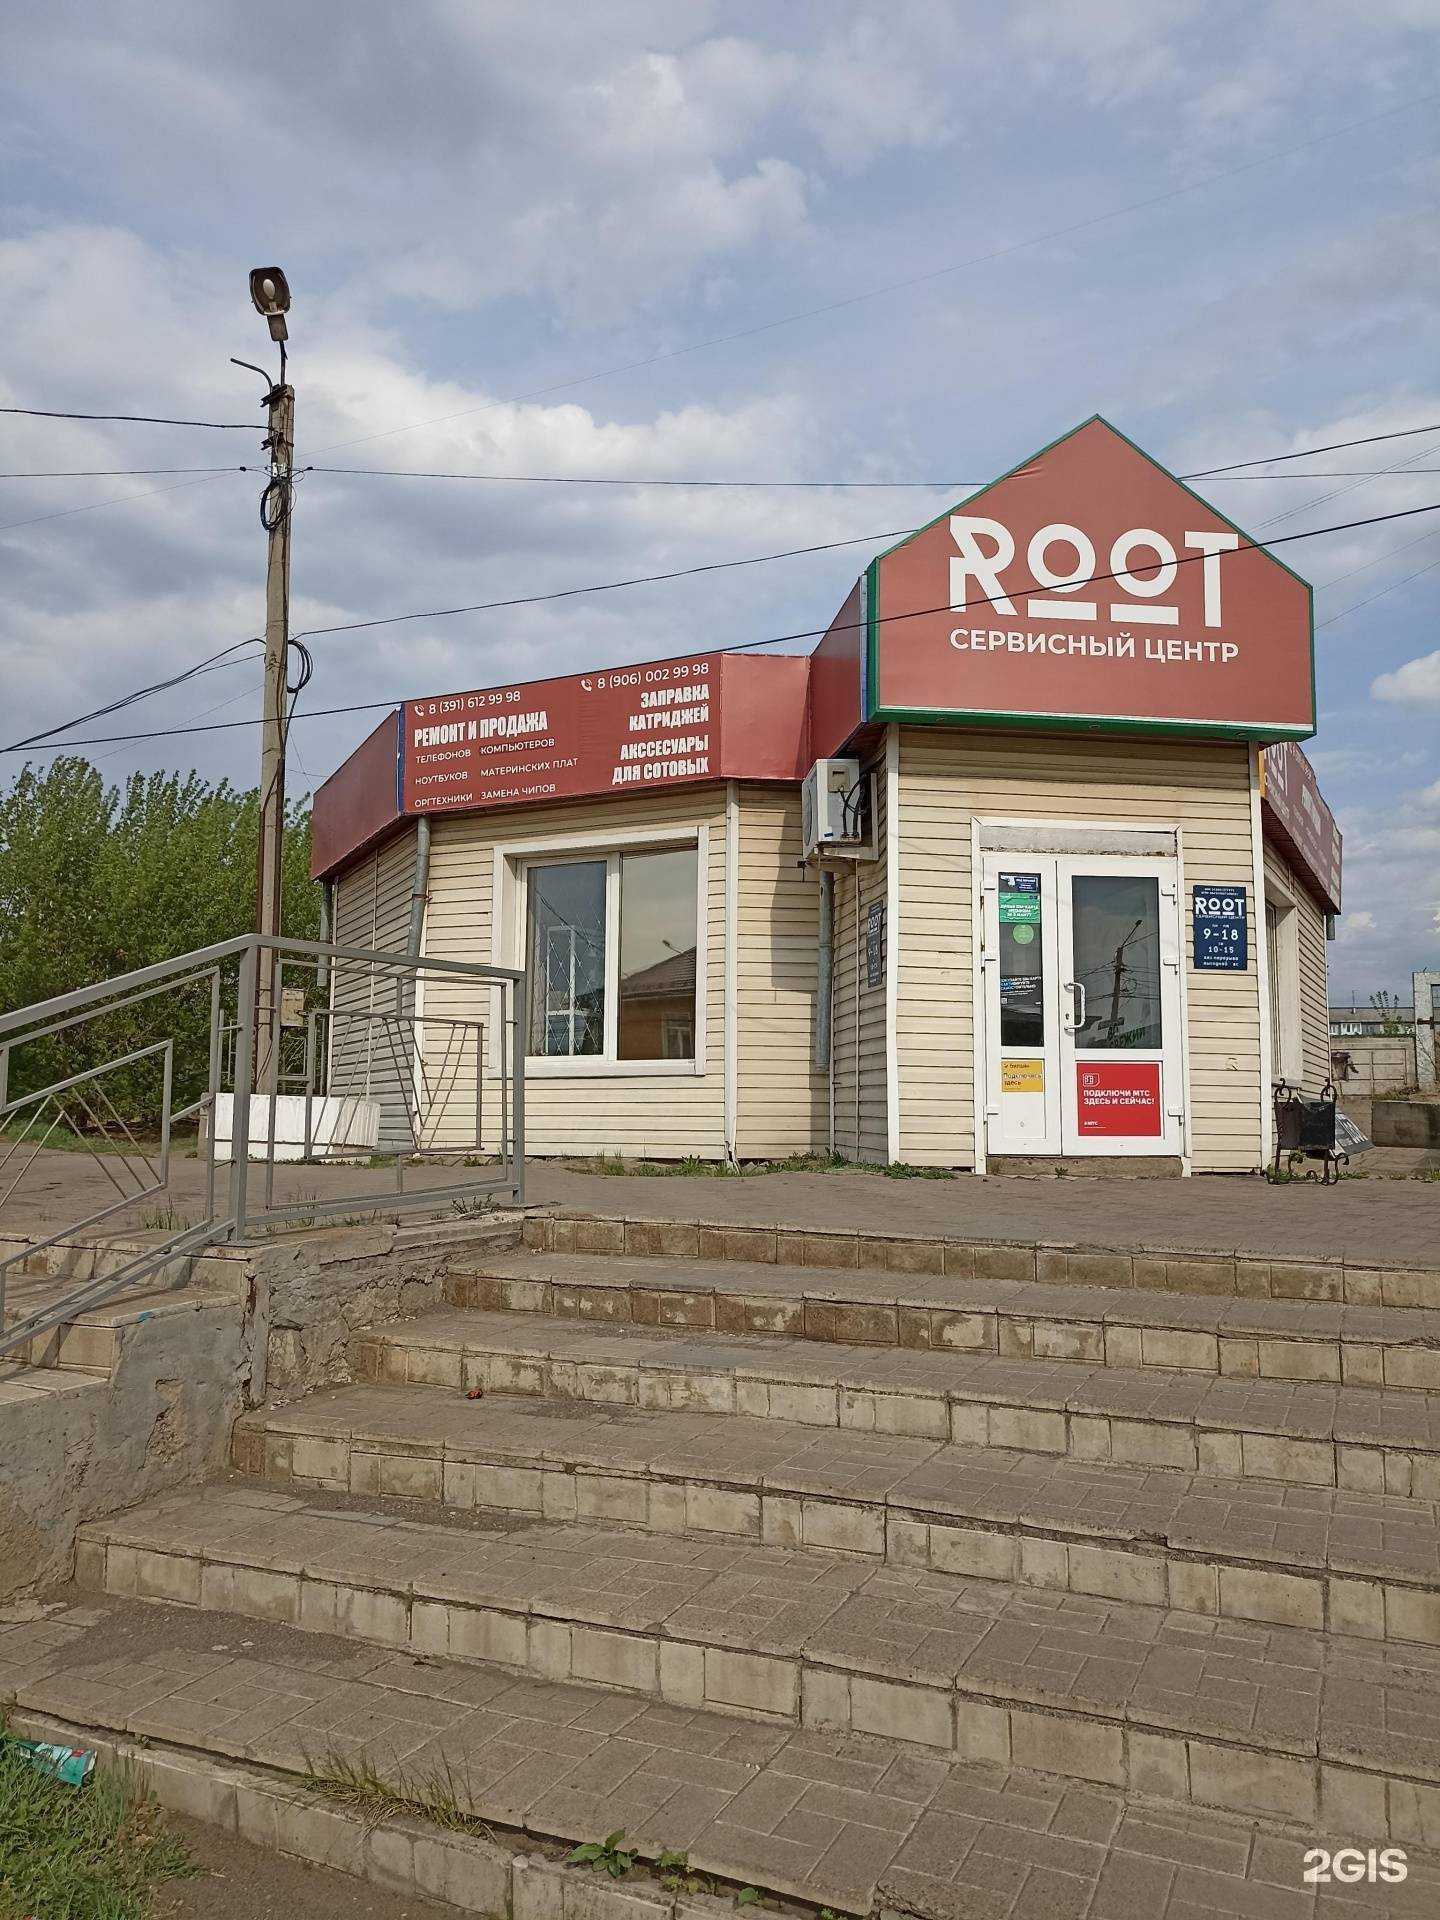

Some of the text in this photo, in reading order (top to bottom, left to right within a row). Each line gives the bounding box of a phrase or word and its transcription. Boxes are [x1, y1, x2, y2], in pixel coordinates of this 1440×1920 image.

[949, 514, 1239, 628] ROOT
[950, 628, 1239, 663] СЕРВИСНЫЙ ЦЕНТР
[597, 662, 709, 689] 8 (906) 002 99 98
[428, 691, 521, 715] 8 (391) 612 99 98
[640, 684, 710, 708] ЗАПРАВКА
[629, 703, 710, 731] КАТРИДЖЕЙ
[414, 710, 549, 748] РЕМОНТ И ПРОДАЖА
[415, 748, 472, 764] ТЕЛЕФОНОВ
[480, 738, 555, 755] КОМПЬЮТЕРОВ
[620, 734, 709, 760] АКССЕСУАРЫ
[480, 757, 578, 777] МАТЕРИНСКИХ ПЛАТ
[612, 756, 710, 785] ДЛЯ СОТОВЫХ
[415, 771, 468, 785] НОУТБУКОВ
[414, 793, 473, 808] ОРГТЕХНИКИ
[480, 783, 556, 800] ЗАМЕНА ЧИПОВ
[1195, 897, 1244, 916] ROOT
[1203, 928, 1239, 941] 9-18
[1208, 946, 1234, 954] 10-15
[1119, 1097, 1155, 1105] СЕЙЧАС!
